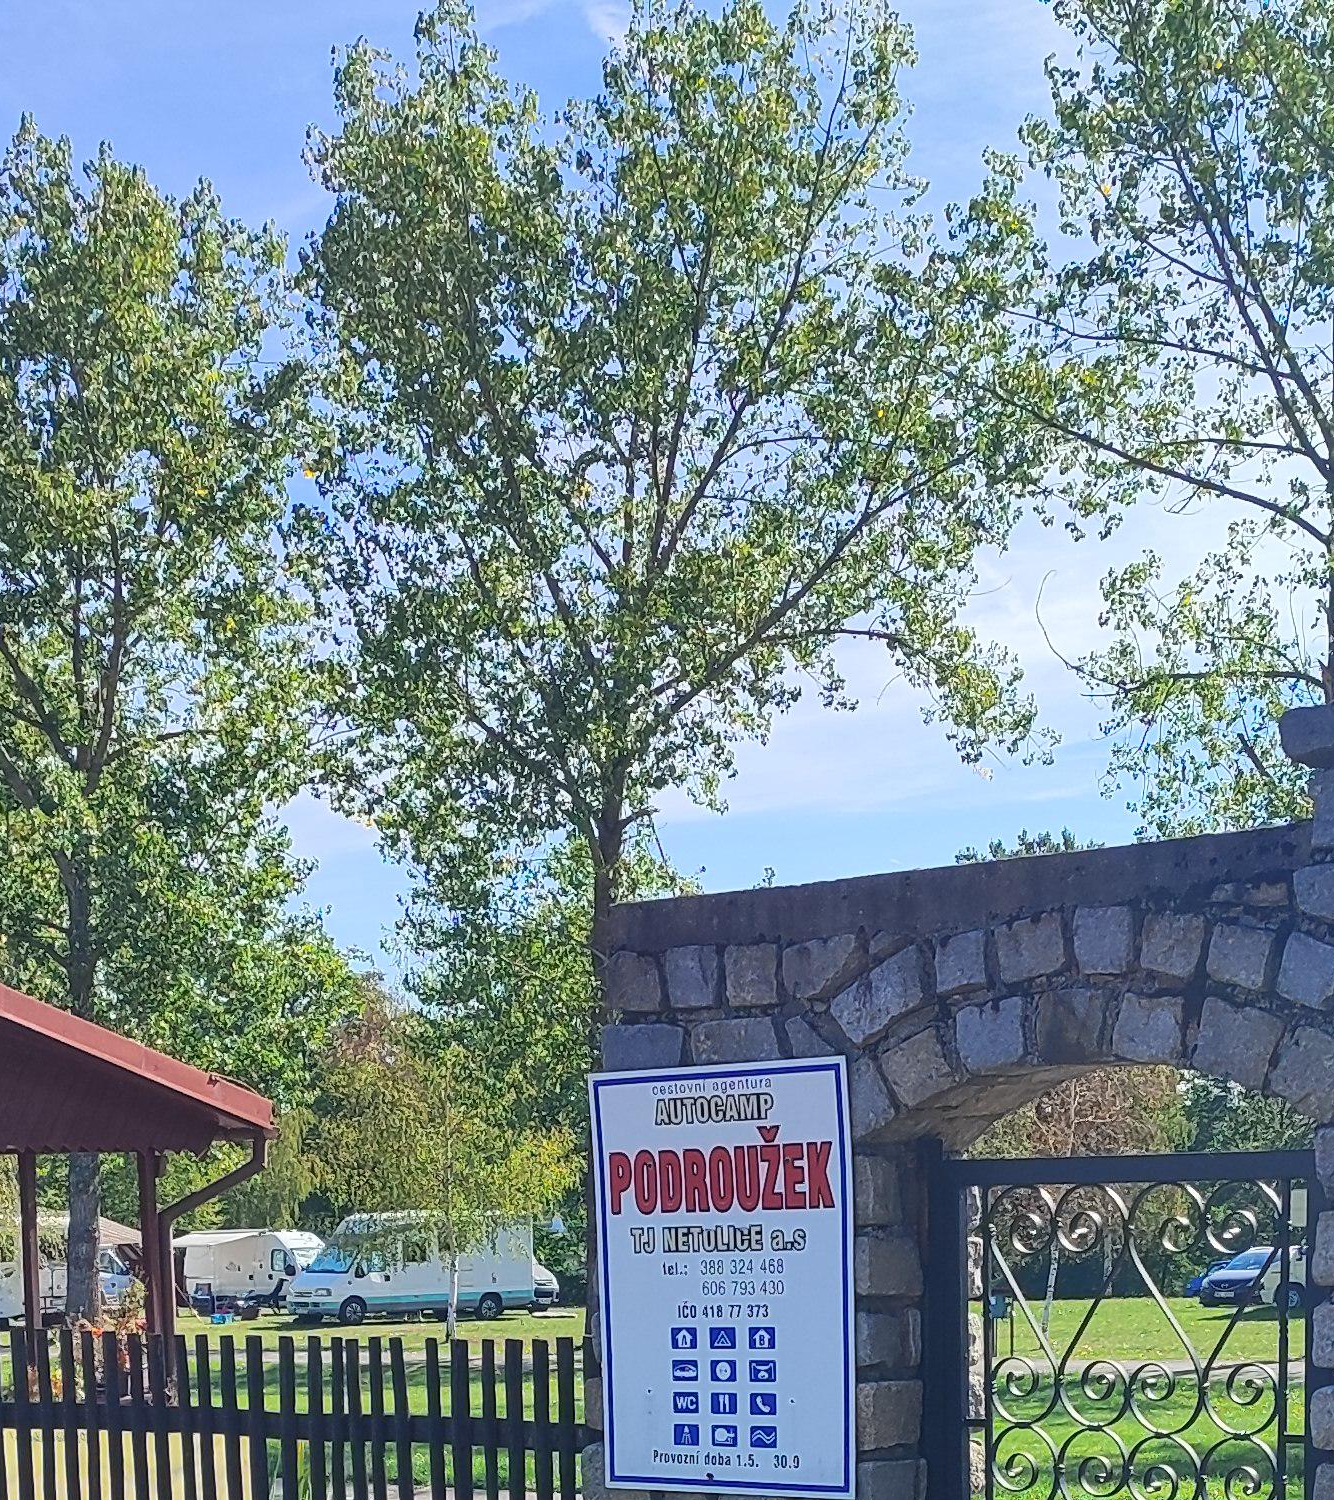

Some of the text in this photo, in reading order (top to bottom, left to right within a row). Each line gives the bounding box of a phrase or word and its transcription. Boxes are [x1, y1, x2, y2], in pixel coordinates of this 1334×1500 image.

[651, 1077, 772, 1096] cestovní agentura
[654, 1092, 774, 1126] AUTOCAMP
[608, 1124, 836, 1216] PODROUŽEK
[630, 1226, 656, 1253] TJ
[662, 1224, 763, 1253] NETOLICE
[729, 1258, 754, 1275] 324
[759, 1258, 784, 1274] 468
[702, 1279, 785, 1295] 606 793 430
[677, 1301, 769, 1318] IČO 418 77 373
[675, 1395, 697, 1410] WC
[653, 1450, 700, 1465] Provozní
[704, 1451, 731, 1466] doba
[737, 1454, 759, 1467] 1.5.
